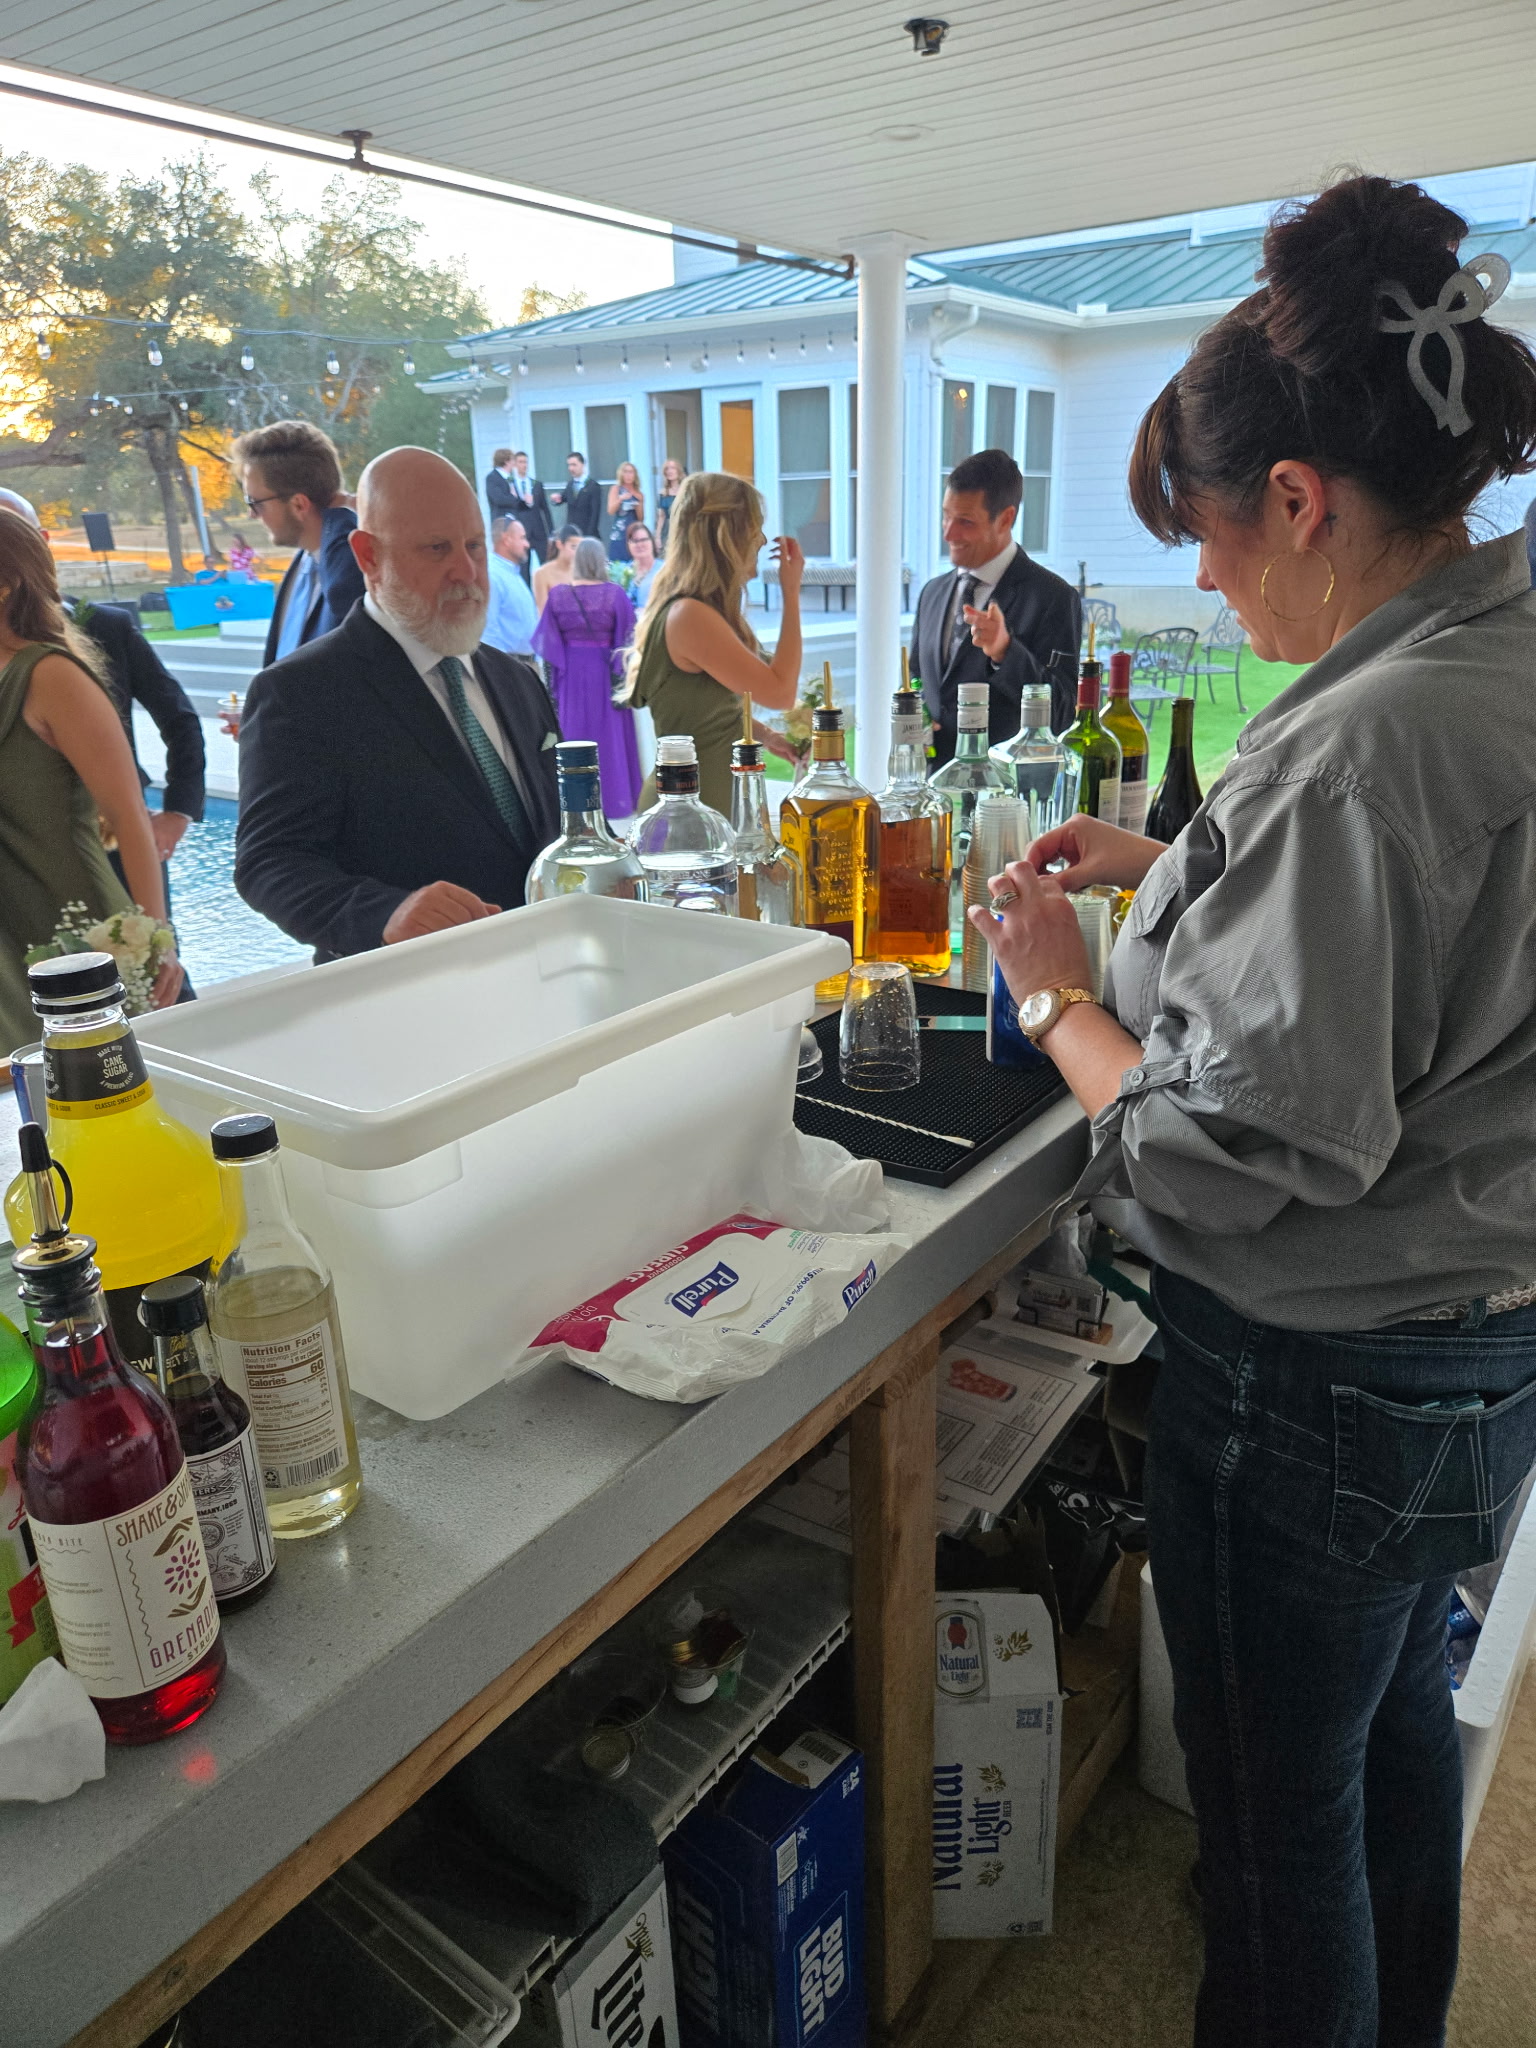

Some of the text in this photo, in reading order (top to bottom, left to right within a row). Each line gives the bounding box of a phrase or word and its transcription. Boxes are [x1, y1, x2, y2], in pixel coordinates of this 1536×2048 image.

[102, 1063, 129, 1079] SUGAR
[103, 1054, 124, 1068] CANE
[94, 1099, 117, 1110] CLASSIC
[117, 1094, 134, 1105] SWEET
[137, 1088, 146, 1098] SOUR
[646, 1255, 686, 1280] FOODSERVICE
[674, 1270, 738, 1311] Purell
[843, 1267, 876, 1305] Purell
[784, 1295, 795, 1307] OF
[243, 1331, 321, 1356] Nutrition Facts
[310, 1358, 324, 1374] 60
[248, 1377, 287, 1387] Calories
[187, 1628, 215, 1661] SYRUP
[940, 1654, 980, 1671] Natural
[950, 1671, 969, 1684] Light
[849, 1765, 860, 1791] 24
[1002, 1800, 1012, 1818] BEER
[966, 1799, 1012, 1855] Light
[634, 1912, 654, 1959] Miller
[822, 1915, 845, 1999] BUD
[800, 1926, 825, 2040] LIGHT
